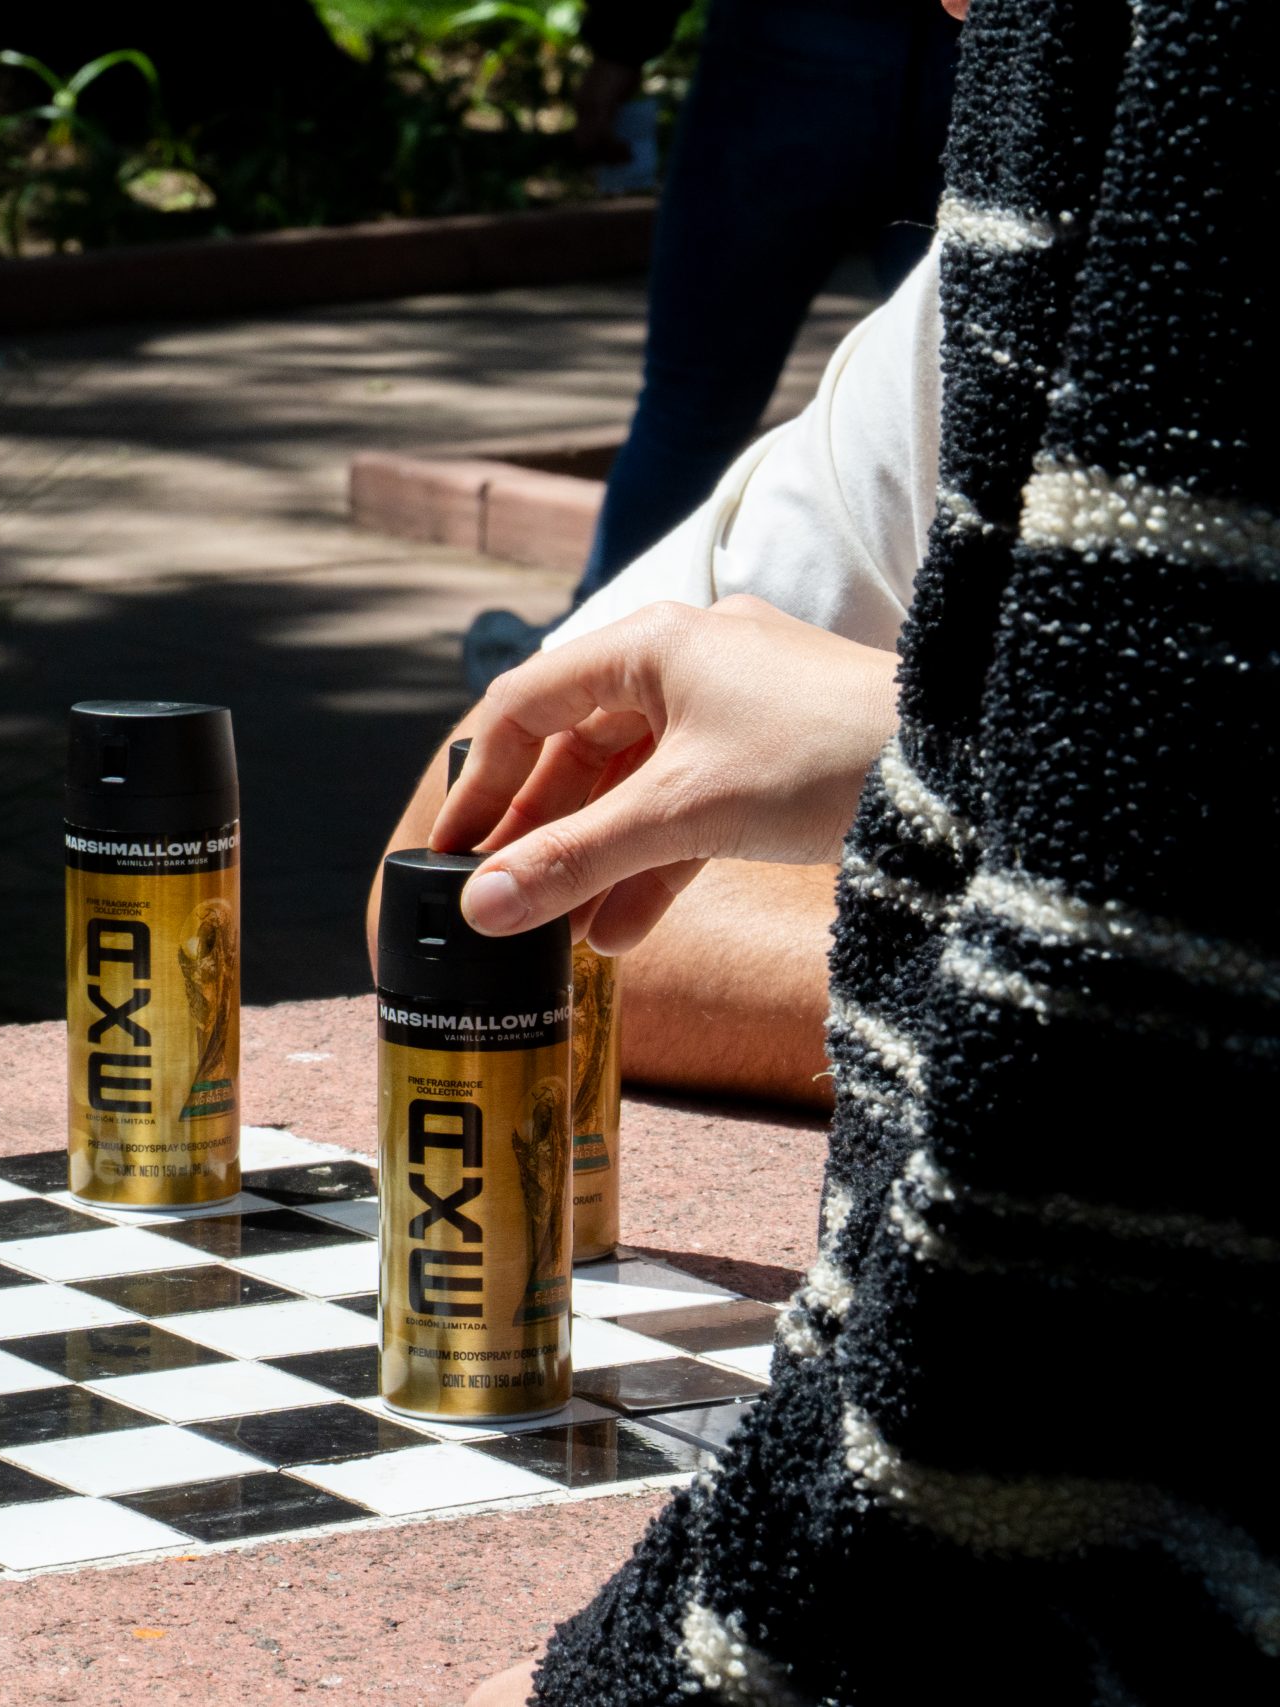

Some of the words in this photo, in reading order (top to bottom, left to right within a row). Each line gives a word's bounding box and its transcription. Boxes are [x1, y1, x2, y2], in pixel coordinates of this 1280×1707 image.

[65, 833, 202, 857] MARSHMALLOW
[116, 859, 154, 867] VAINILLA
[164, 858, 186, 867] DARK
[188, 857, 209, 865] MUSK
[102, 899, 151, 909] FRAGRANCE
[94, 907, 142, 916] COLLECTION
[87, 918, 151, 1114] AXE
[380, 1004, 537, 1030] MARSHMALLOW
[444, 1032, 486, 1041] VAINILLA
[498, 1032, 521, 1041] DARK
[523, 1030, 545, 1039] MUSK
[408, 1075, 424, 1085] FINE
[426, 1078, 483, 1089] FRAGRANCE
[416, 1086, 473, 1097] COLLECTION
[86, 1113, 114, 1123] EDICIÓN
[117, 1117, 156, 1125] LIMITADA
[88, 1139, 123, 1151] PREMIUM
[126, 1144, 178, 1153] BODYSPRAY
[139, 1165, 160, 1177] NETO
[162, 1165, 176, 1177] 150
[573, 1193, 602, 1205] ORANTE
[408, 1098, 483, 1318] AXE
[405, 1316, 440, 1328] EDICIÓN
[442, 1321, 488, 1331] LIMITADA
[408, 1345, 451, 1361] PREMIUM
[453, 1349, 511, 1361] BODYSPRAY
[468, 1374, 491, 1389] NETO
[493, 1374, 509, 1388] 150
